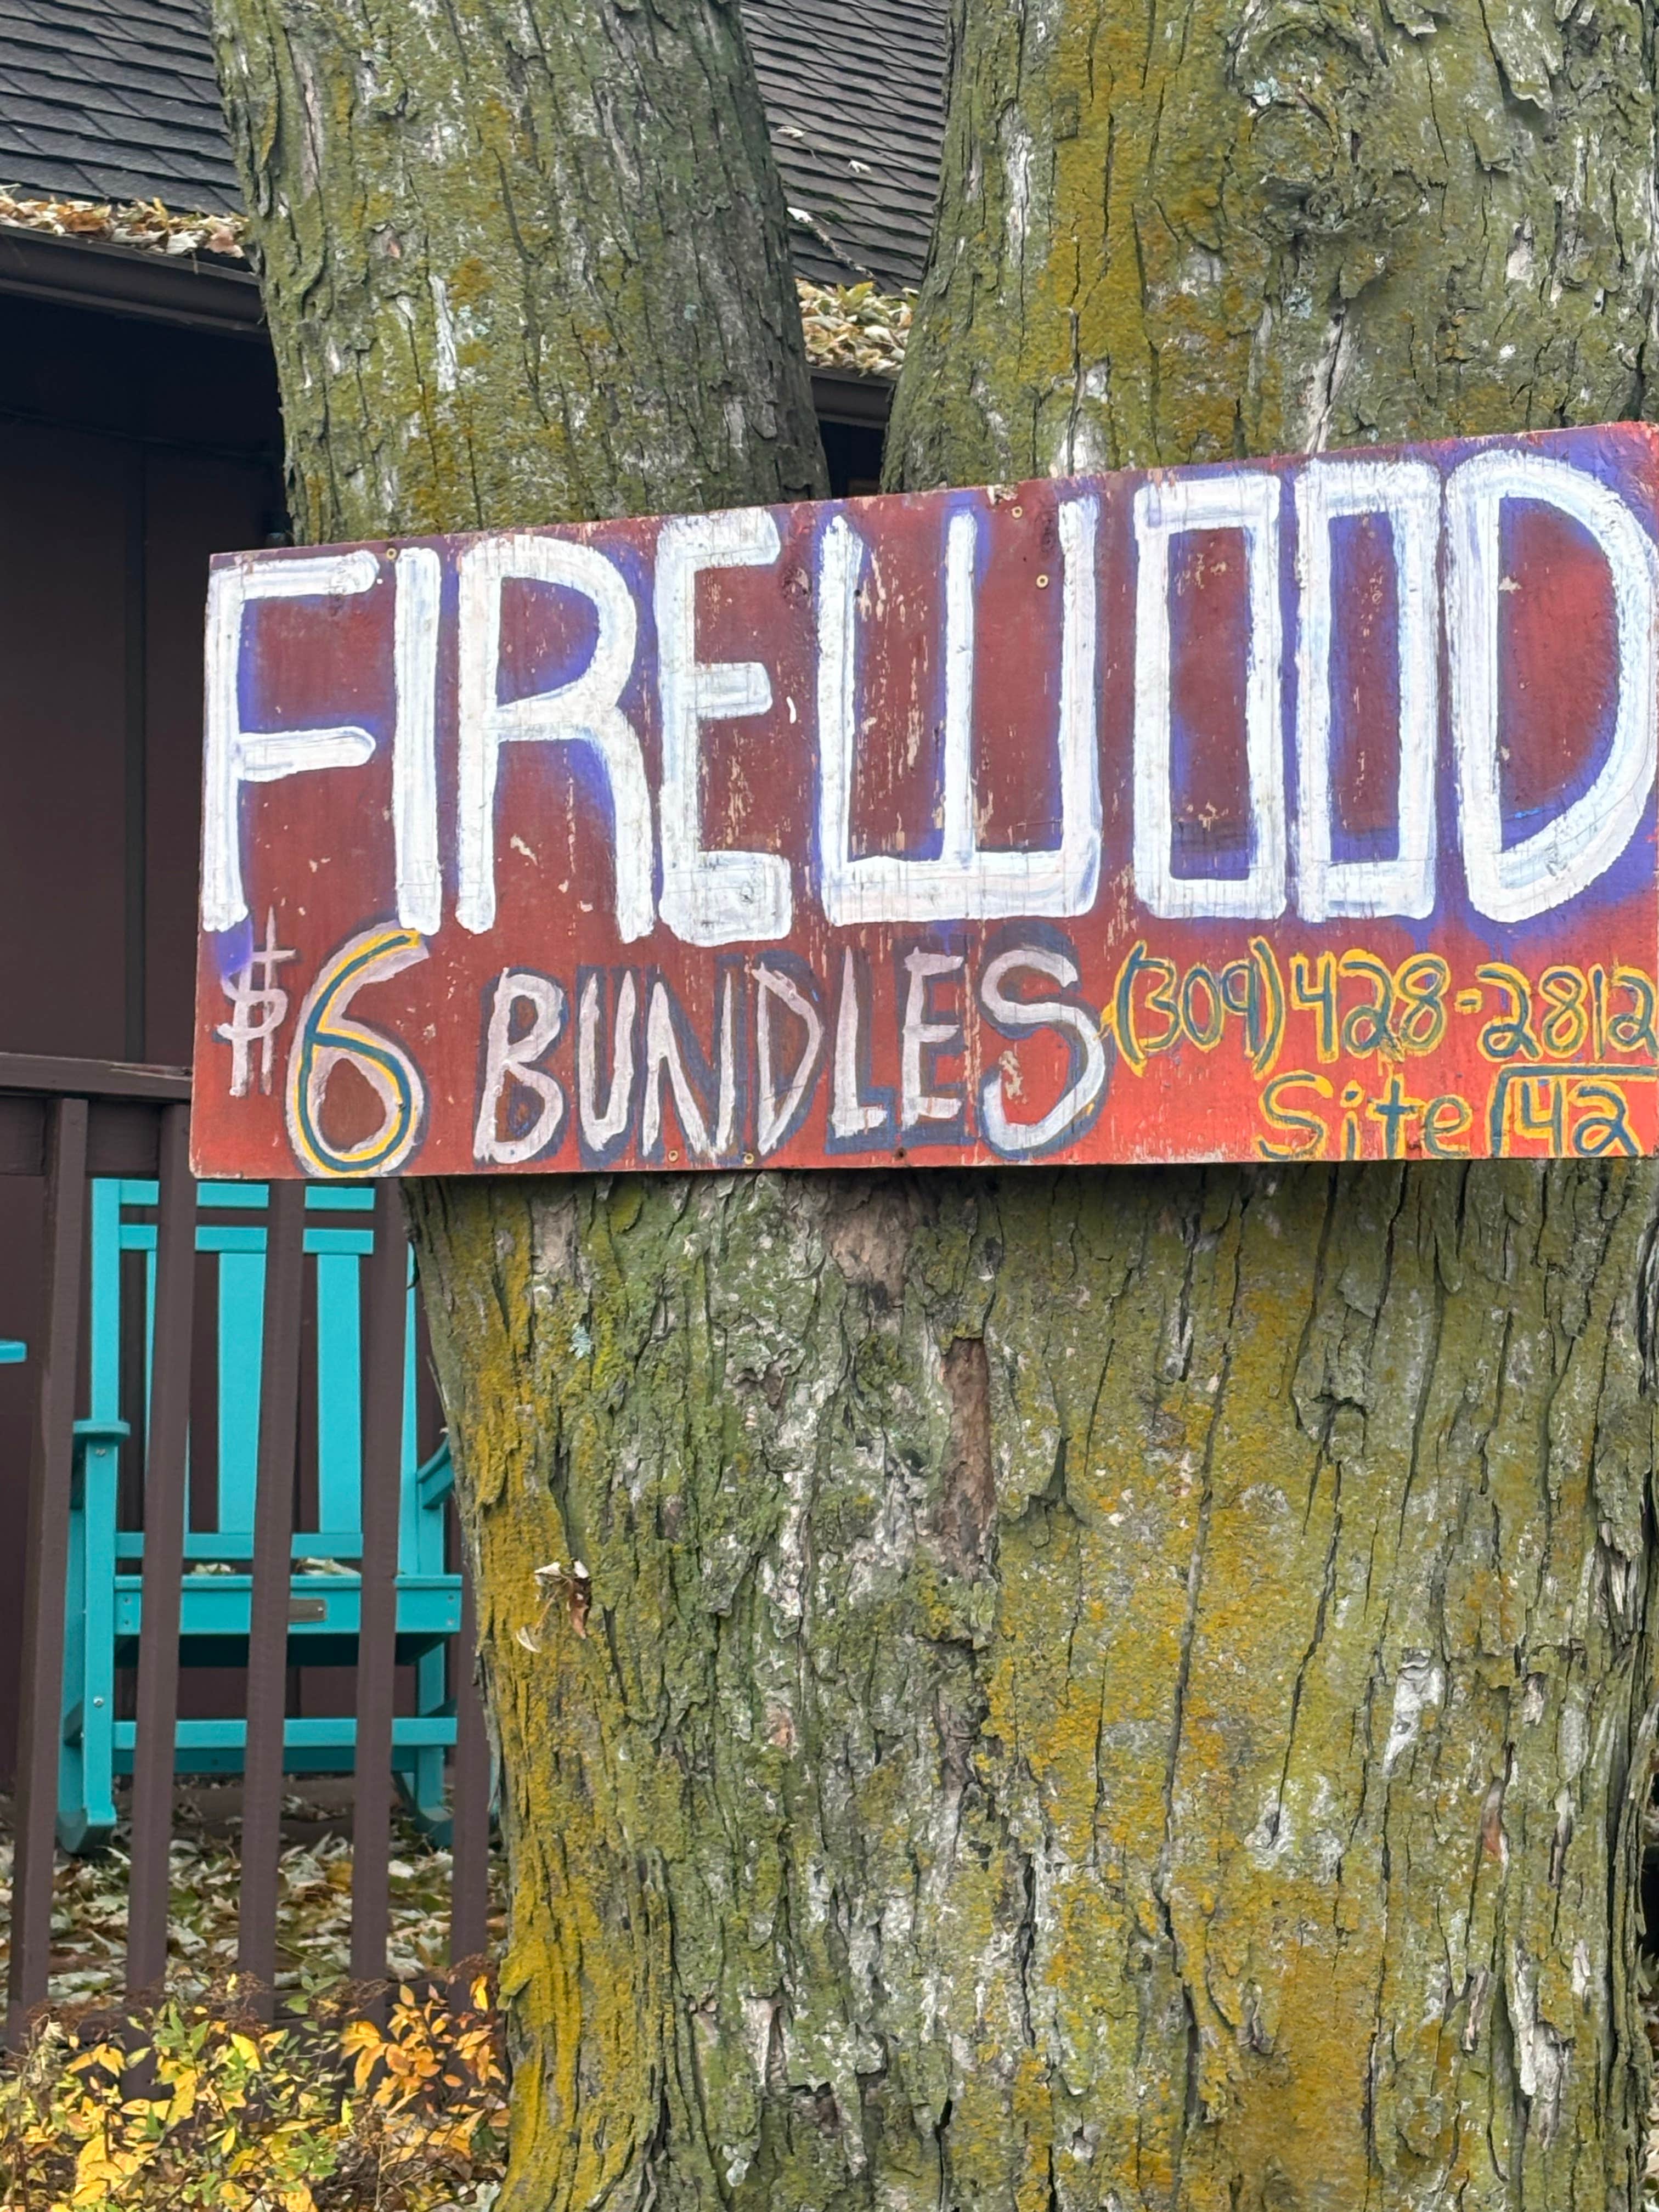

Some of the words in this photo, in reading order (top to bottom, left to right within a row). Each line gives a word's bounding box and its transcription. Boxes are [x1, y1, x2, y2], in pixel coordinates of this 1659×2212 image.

[203, 449, 1658, 946] FIREWOOD
[211, 906, 430, 1177] $6
[473, 945, 1106, 1164] BUNDLES
[1256, 1070, 1472, 1160] Site
